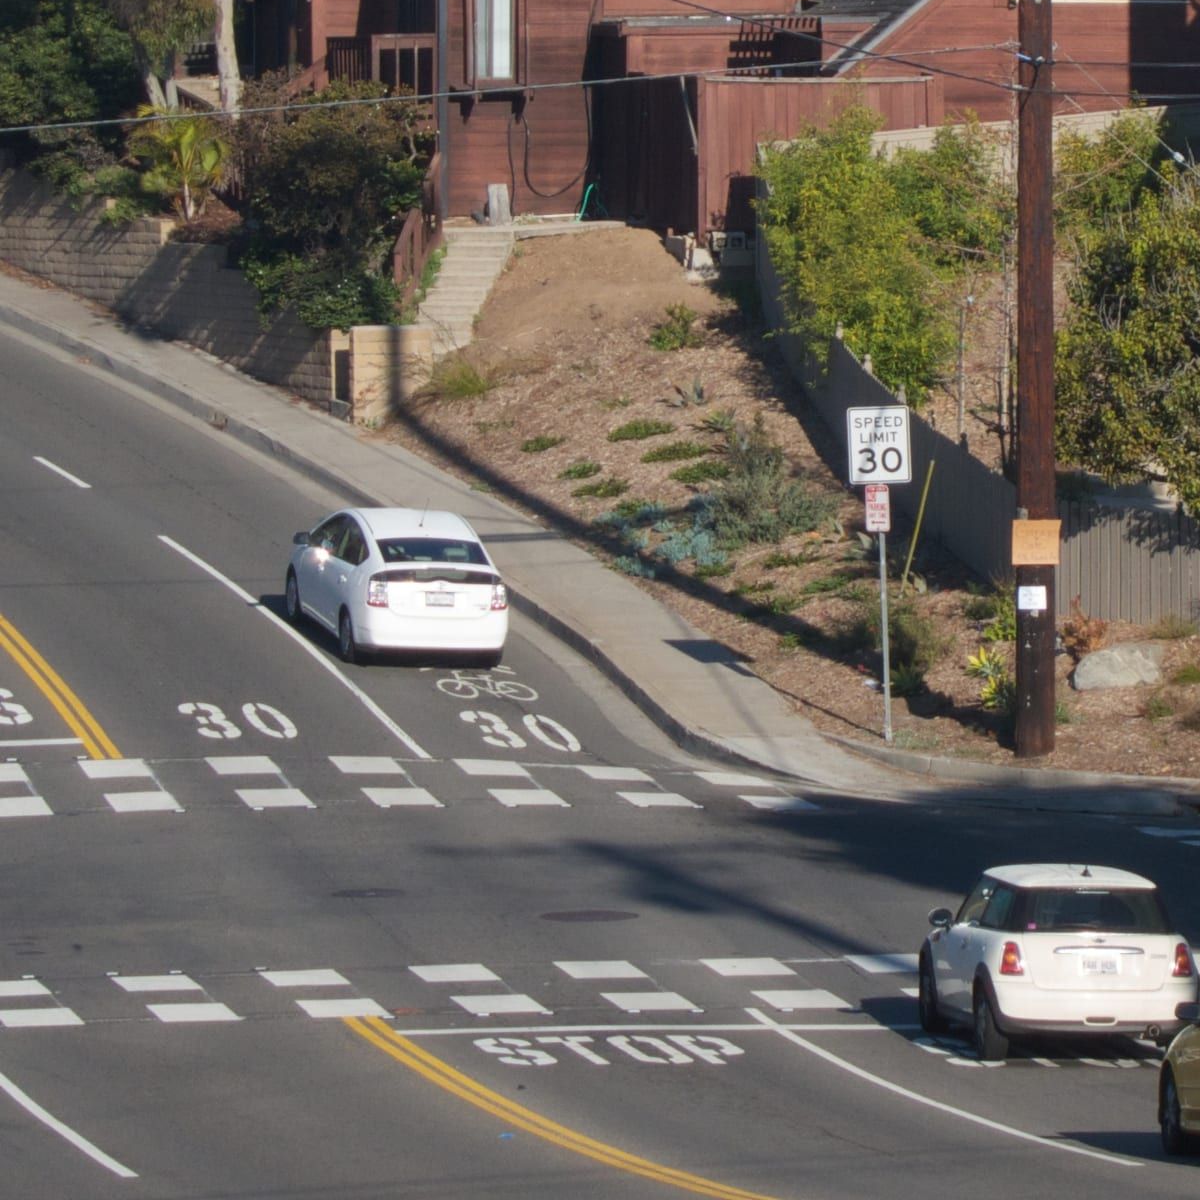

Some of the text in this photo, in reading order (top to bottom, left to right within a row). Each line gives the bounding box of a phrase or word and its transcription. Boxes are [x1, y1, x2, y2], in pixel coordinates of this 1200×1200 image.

[854, 415, 903, 429] SPEED
[860, 431, 898, 444] LIMIT
[858, 446, 903, 474] 30
[178, 702, 298, 739] 30
[459, 710, 582, 752] 30
[473, 1035, 745, 1066] STOP
